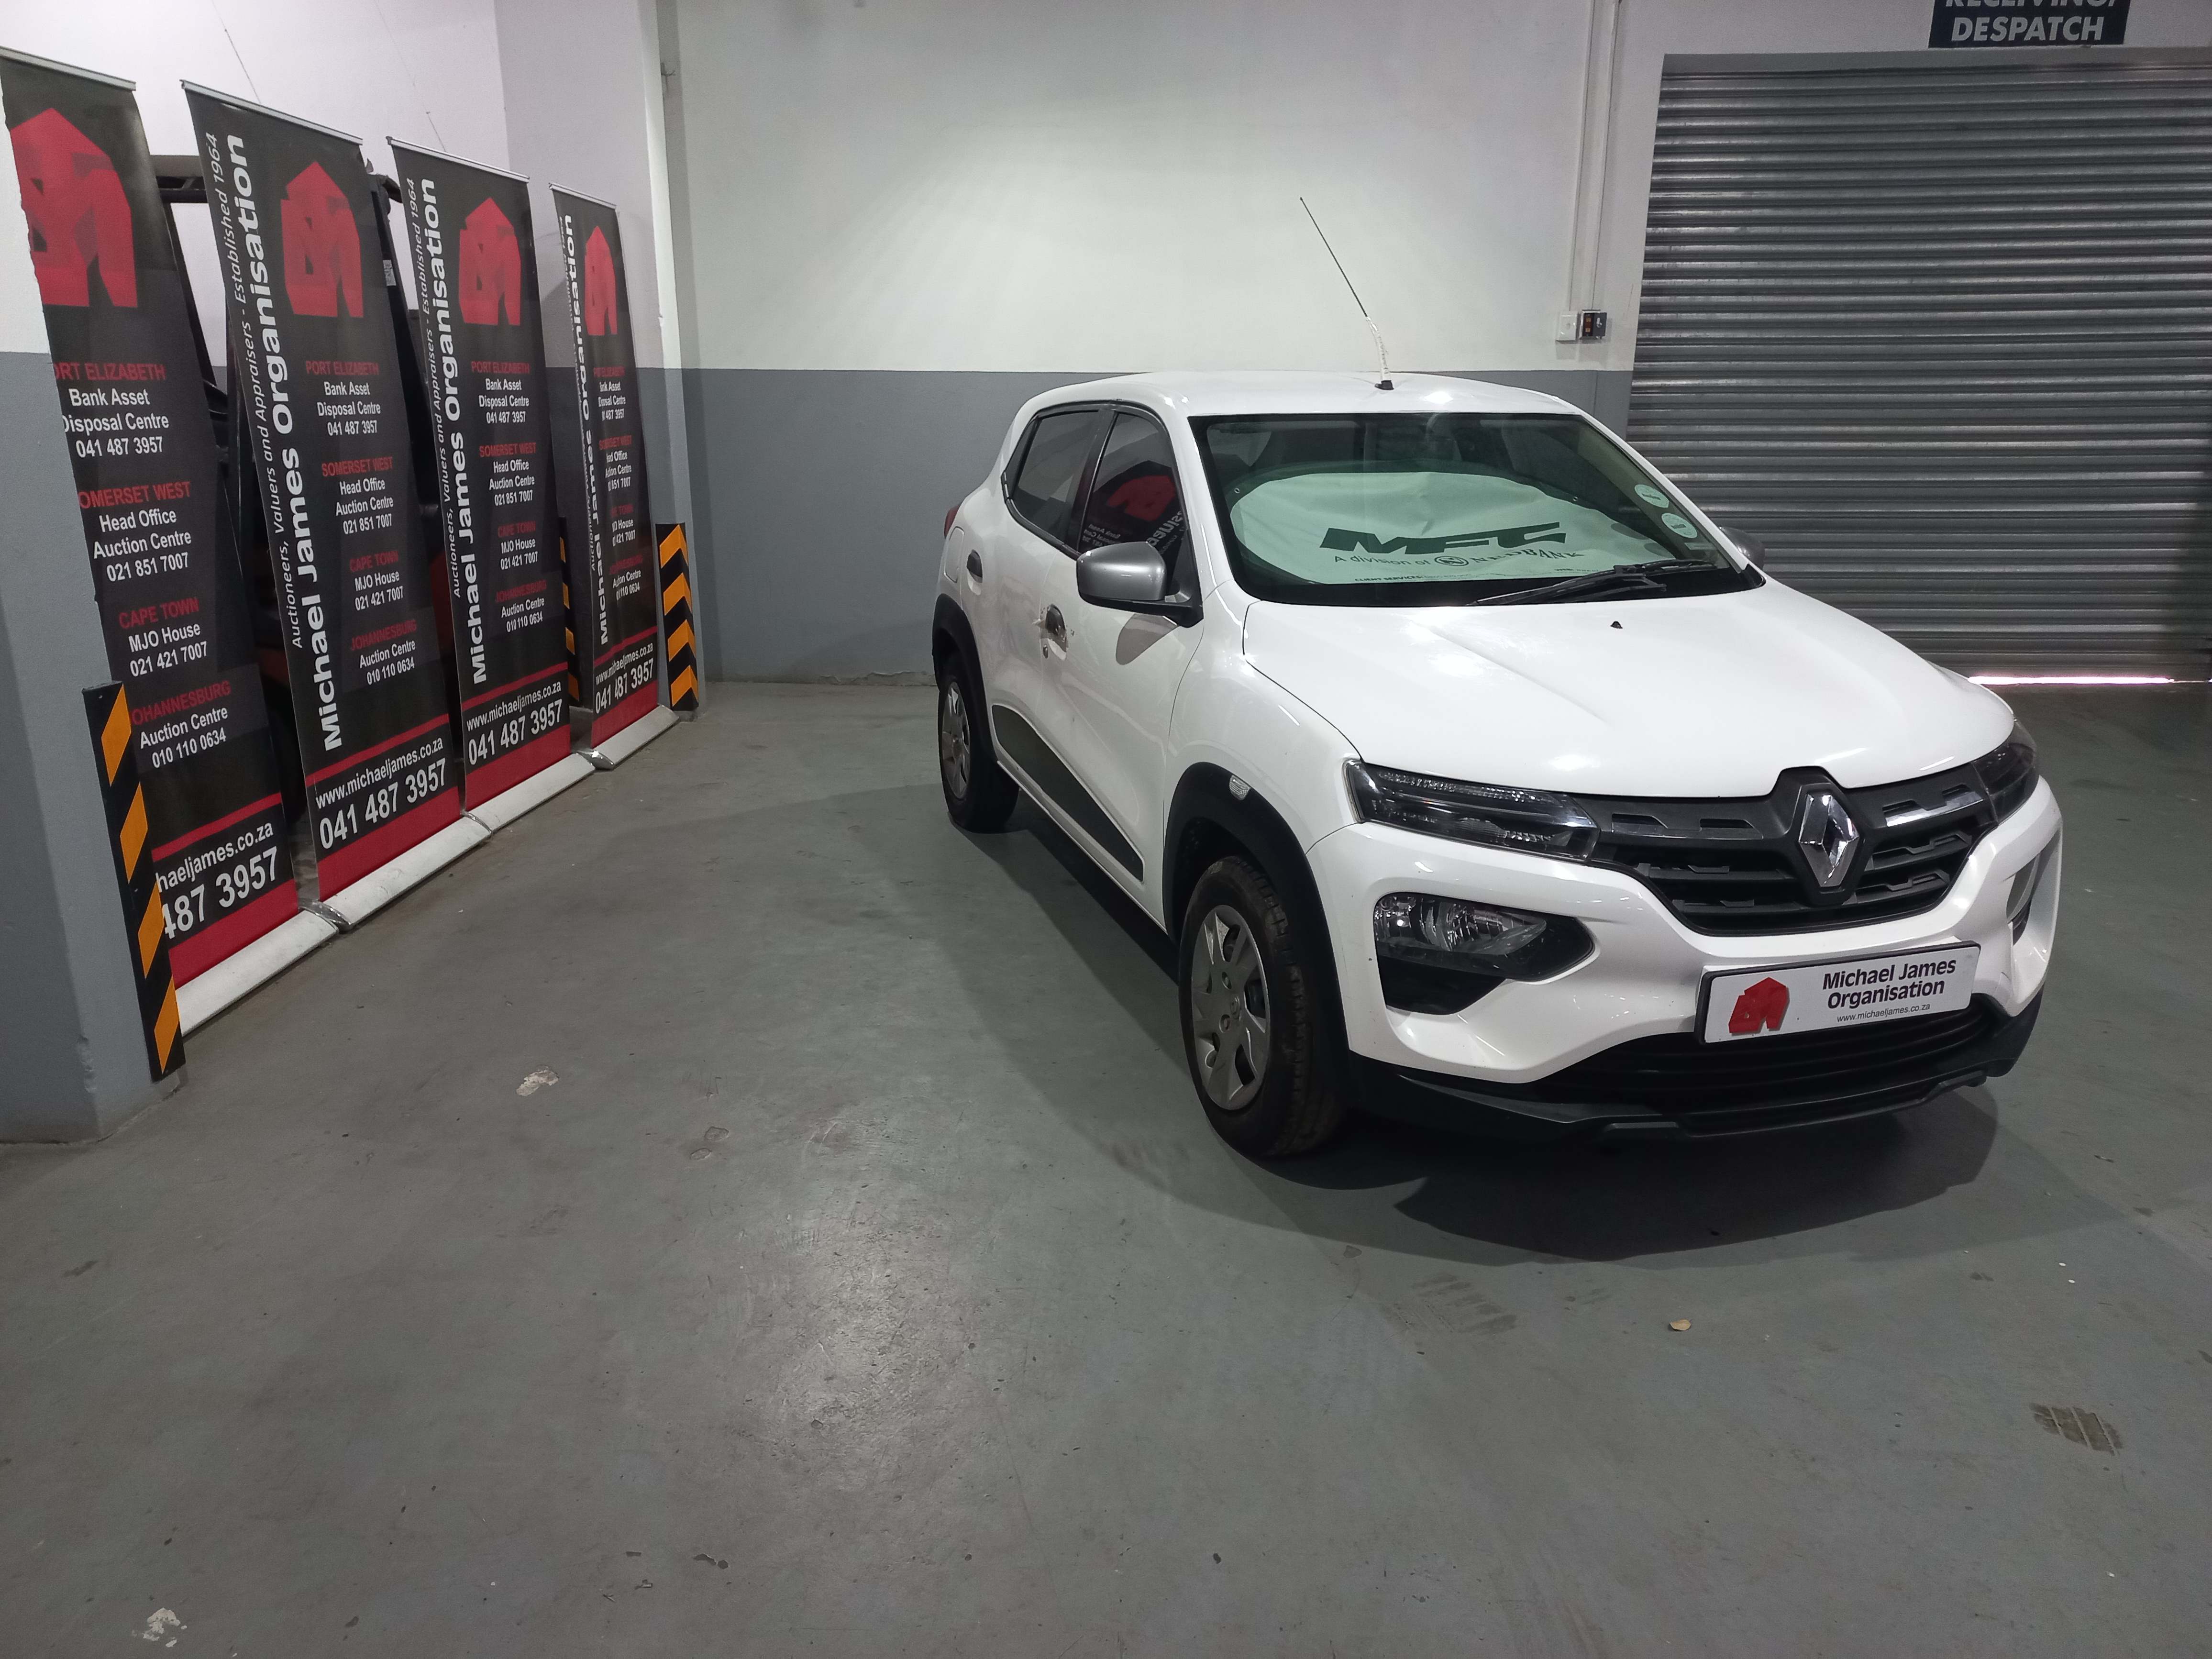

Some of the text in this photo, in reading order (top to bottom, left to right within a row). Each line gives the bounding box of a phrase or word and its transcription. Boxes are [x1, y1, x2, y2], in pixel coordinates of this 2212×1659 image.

[1951, 16, 2104, 42] DESPATCH
[407, 177, 419, 218] 1964
[415, 222, 430, 314] Established
[84, 362, 166, 380] ELIZABETH
[306, 361, 331, 375] PORT
[427, 329, 441, 410] Appraisers
[206, 132, 302, 648] Auctioneers, Valuers and Appraisers Established 1964
[324, 381, 370, 396] Bank Asset
[486, 378, 521, 390] Bank Asset
[68, 388, 150, 406] Bank Asset
[317, 401, 381, 418] Disposal Centre
[479, 395, 530, 409] Disposal Centre
[125, 413, 169, 430] Centre
[327, 420, 377, 436] 041 487 3957
[435, 413, 444, 443] and
[487, 411, 526, 424] 041 487 3957
[227, 134, 342, 751] Michael James Organisation
[421, 179, 487, 684] Michael James Organisation
[76, 436, 163, 458] 041 487 3957
[614, 451, 628, 461] Office
[321, 456, 393, 477] SOMERSET WEST
[493, 459, 529, 473] Head Office
[77, 481, 190, 509] OMERSET WEST
[339, 477, 386, 495] Head Office
[489, 475, 535, 490] Auction Centre
[336, 496, 394, 516] Auction Centre
[495, 490, 533, 506] 021 851 7007
[99, 508, 177, 532] Head Office
[343, 513, 392, 534] 021 851 7007
[618, 520, 633, 529] House
[94, 531, 191, 559] Auction Centre
[501, 537, 535, 554] MJO House
[1319, 521, 1566, 554] MFC
[349, 551, 399, 573] CAPE TOWN
[447, 508, 460, 598] Auctioneers,
[500, 551, 538, 570] 021 421 7007
[1350, 555, 1411, 565] division
[107, 552, 188, 582] 021 851 7007
[626, 570, 641, 581] Centre
[354, 571, 399, 592] MJO House
[595, 534, 608, 645] Michael
[629, 582, 640, 594] 0634
[355, 586, 403, 611] 021 421 7007
[501, 597, 544, 618] Auction Centre
[119, 597, 199, 629] CAPE TOWN
[506, 610, 543, 633] 010 110 0634
[128, 623, 201, 653] MJO House
[130, 641, 208, 677] 021 421 7007
[360, 640, 416, 668] Auction Centre
[366, 656, 415, 685] 010 110 0634
[596, 658, 653, 714] 041 487 3957
[131, 680, 232, 726] OHANNESBURG
[466, 680, 562, 731] www.michaeljames.co.za
[140, 707, 228, 749] Auction Centre
[468, 698, 563, 765] 041 487 3957
[152, 727, 226, 768] 010 110 0634
[316, 737, 443, 809] www.michaeljames.co.za
[320, 757, 446, 850] 041 487 3957
[155, 820, 273, 893] haeljames.co.za
[216, 846, 278, 909] 3957
[1823, 959, 1956, 990] Michael James
[1828, 980, 1945, 1009] Organisation
[1837, 1004, 1930, 1023] www.michaeljames.co.za
